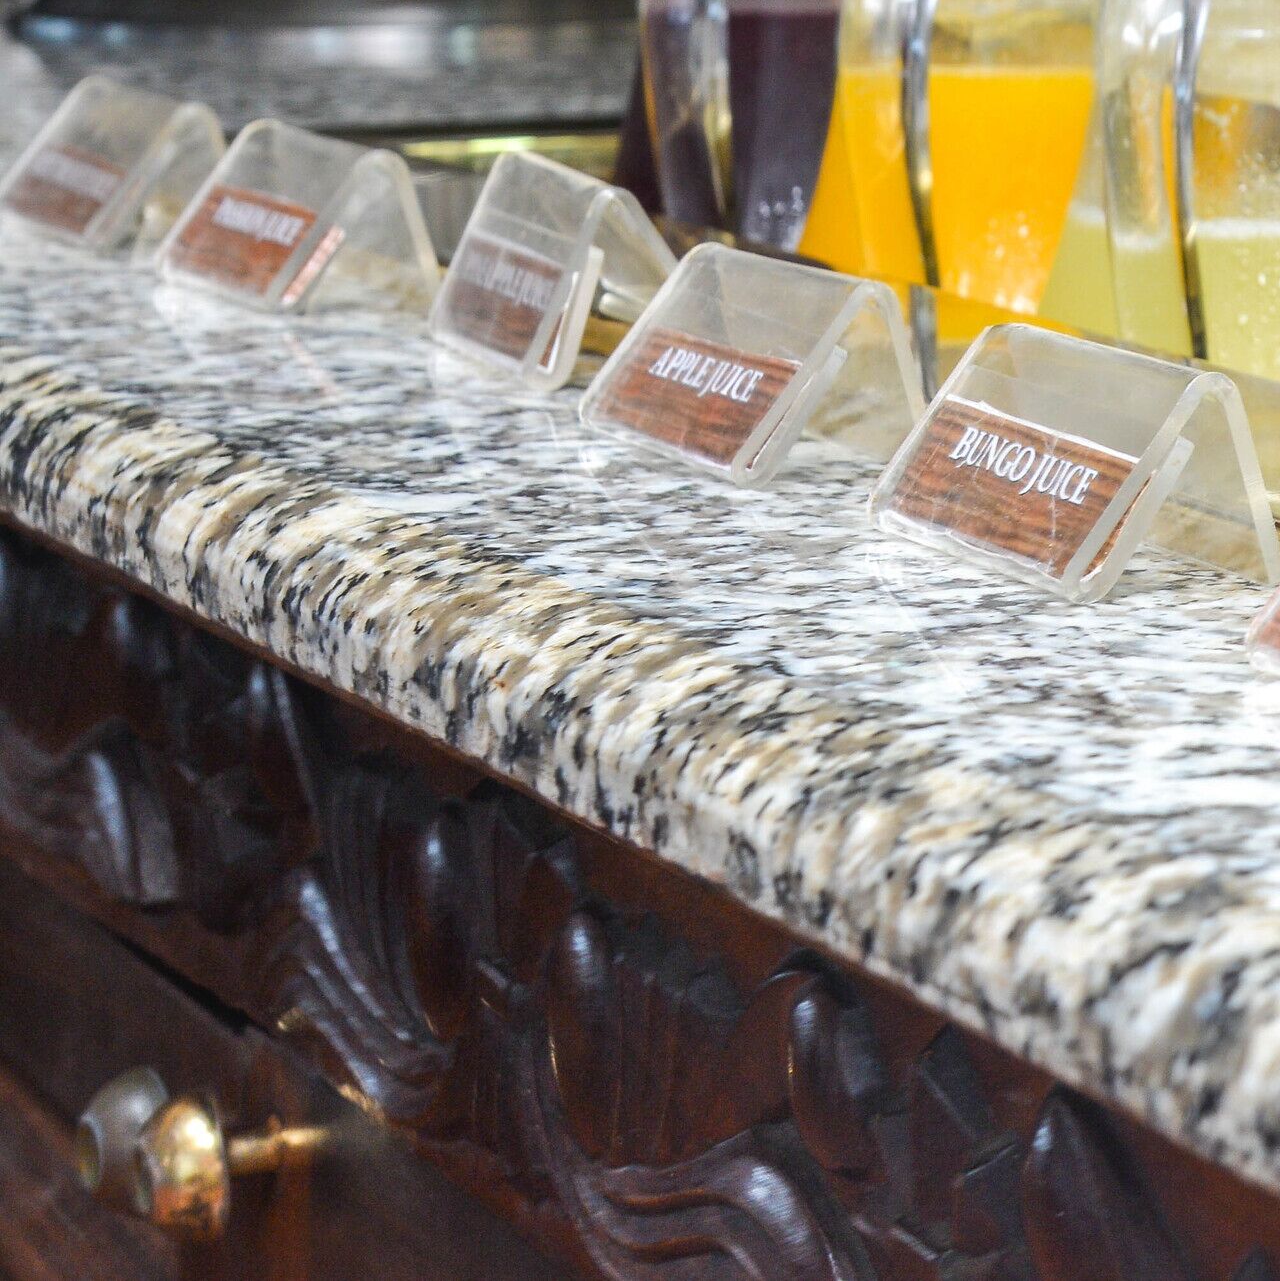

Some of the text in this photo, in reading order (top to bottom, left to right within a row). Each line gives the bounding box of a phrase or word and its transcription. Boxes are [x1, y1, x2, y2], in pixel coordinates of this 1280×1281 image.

[648, 346, 764, 402] APPLE JUICE
[949, 426, 1099, 505] BUNGO JUICE
